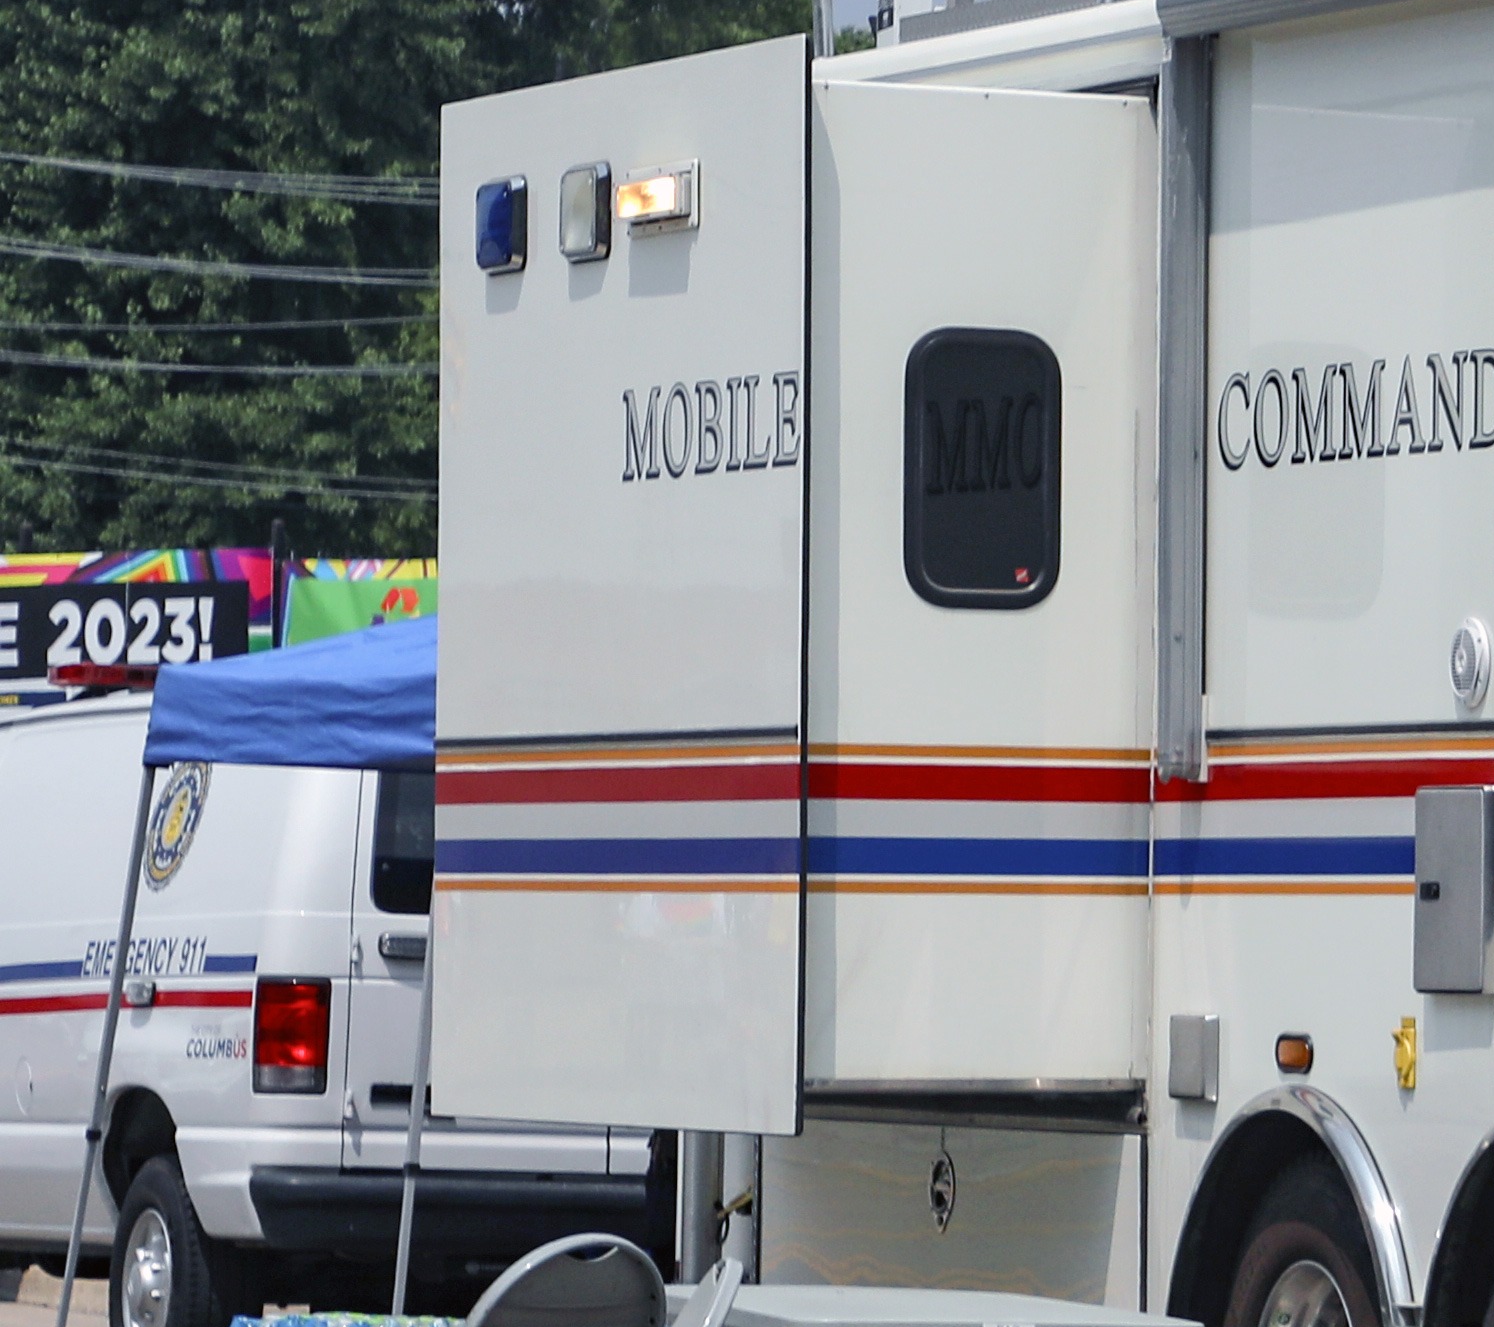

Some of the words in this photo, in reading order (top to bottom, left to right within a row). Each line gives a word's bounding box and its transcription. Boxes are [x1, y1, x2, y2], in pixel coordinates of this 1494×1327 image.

[622, 369, 800, 483] MOBILE
[47, 597, 214, 666] 2023!
[82, 936, 178, 976] EMEGENCY
[179, 935, 208, 974] 911
[186, 1033, 247, 1059] COLUMBUS
